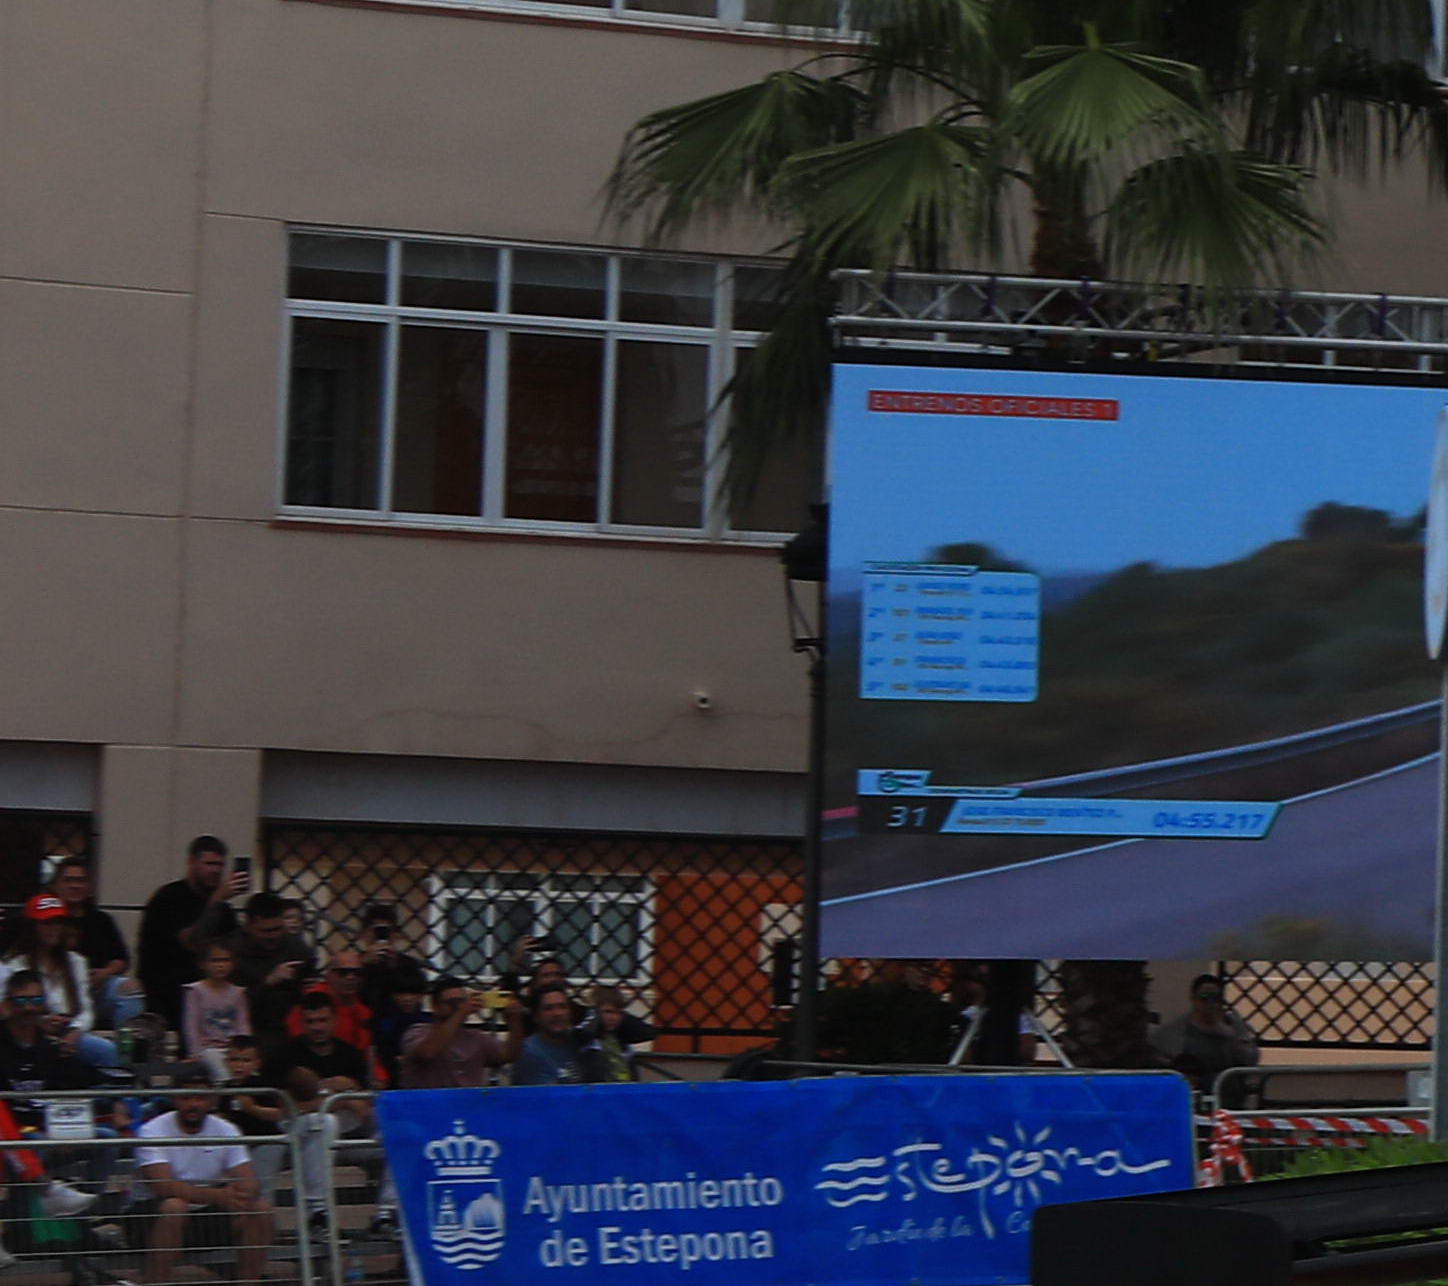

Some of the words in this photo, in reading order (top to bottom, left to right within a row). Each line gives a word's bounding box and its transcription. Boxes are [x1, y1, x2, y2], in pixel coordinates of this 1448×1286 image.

[885, 805, 928, 828] 31
[522, 1171, 784, 1223] Ayuntamiento
[539, 1228, 590, 1268] de
[597, 1225, 776, 1271] Estepona
